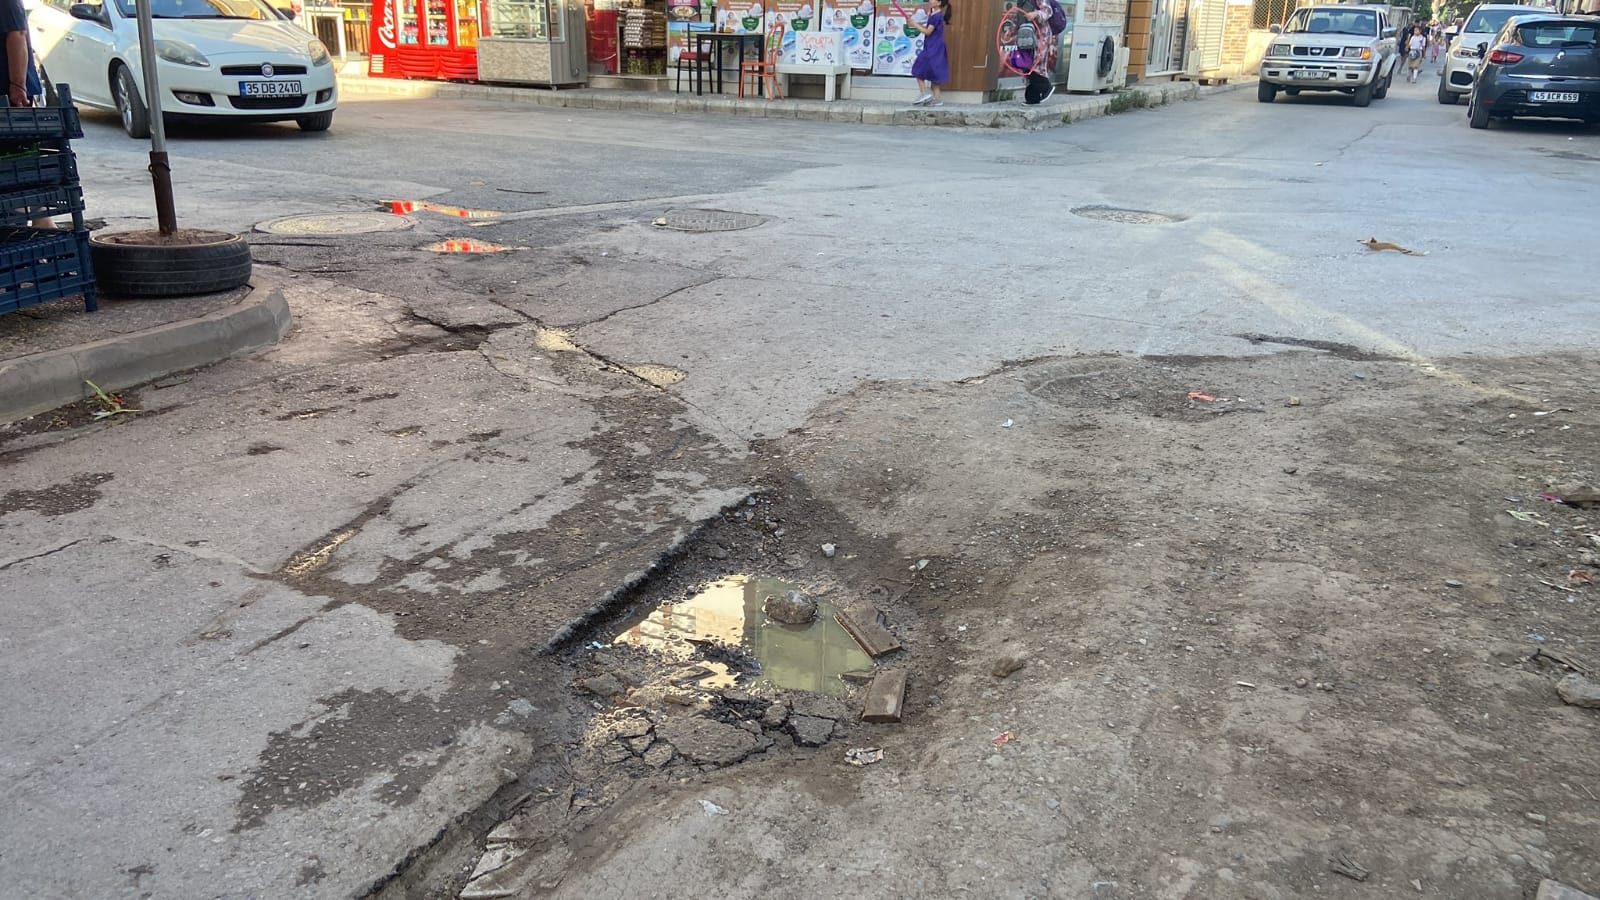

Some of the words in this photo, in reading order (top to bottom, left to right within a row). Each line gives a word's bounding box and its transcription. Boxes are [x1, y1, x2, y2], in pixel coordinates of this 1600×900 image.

[801, 48, 820, 64] 34
[246, 83, 259, 93] 35
[261, 83, 276, 93] DB
[279, 82, 299, 93] 2410
[1563, 93, 1578, 101] 659
